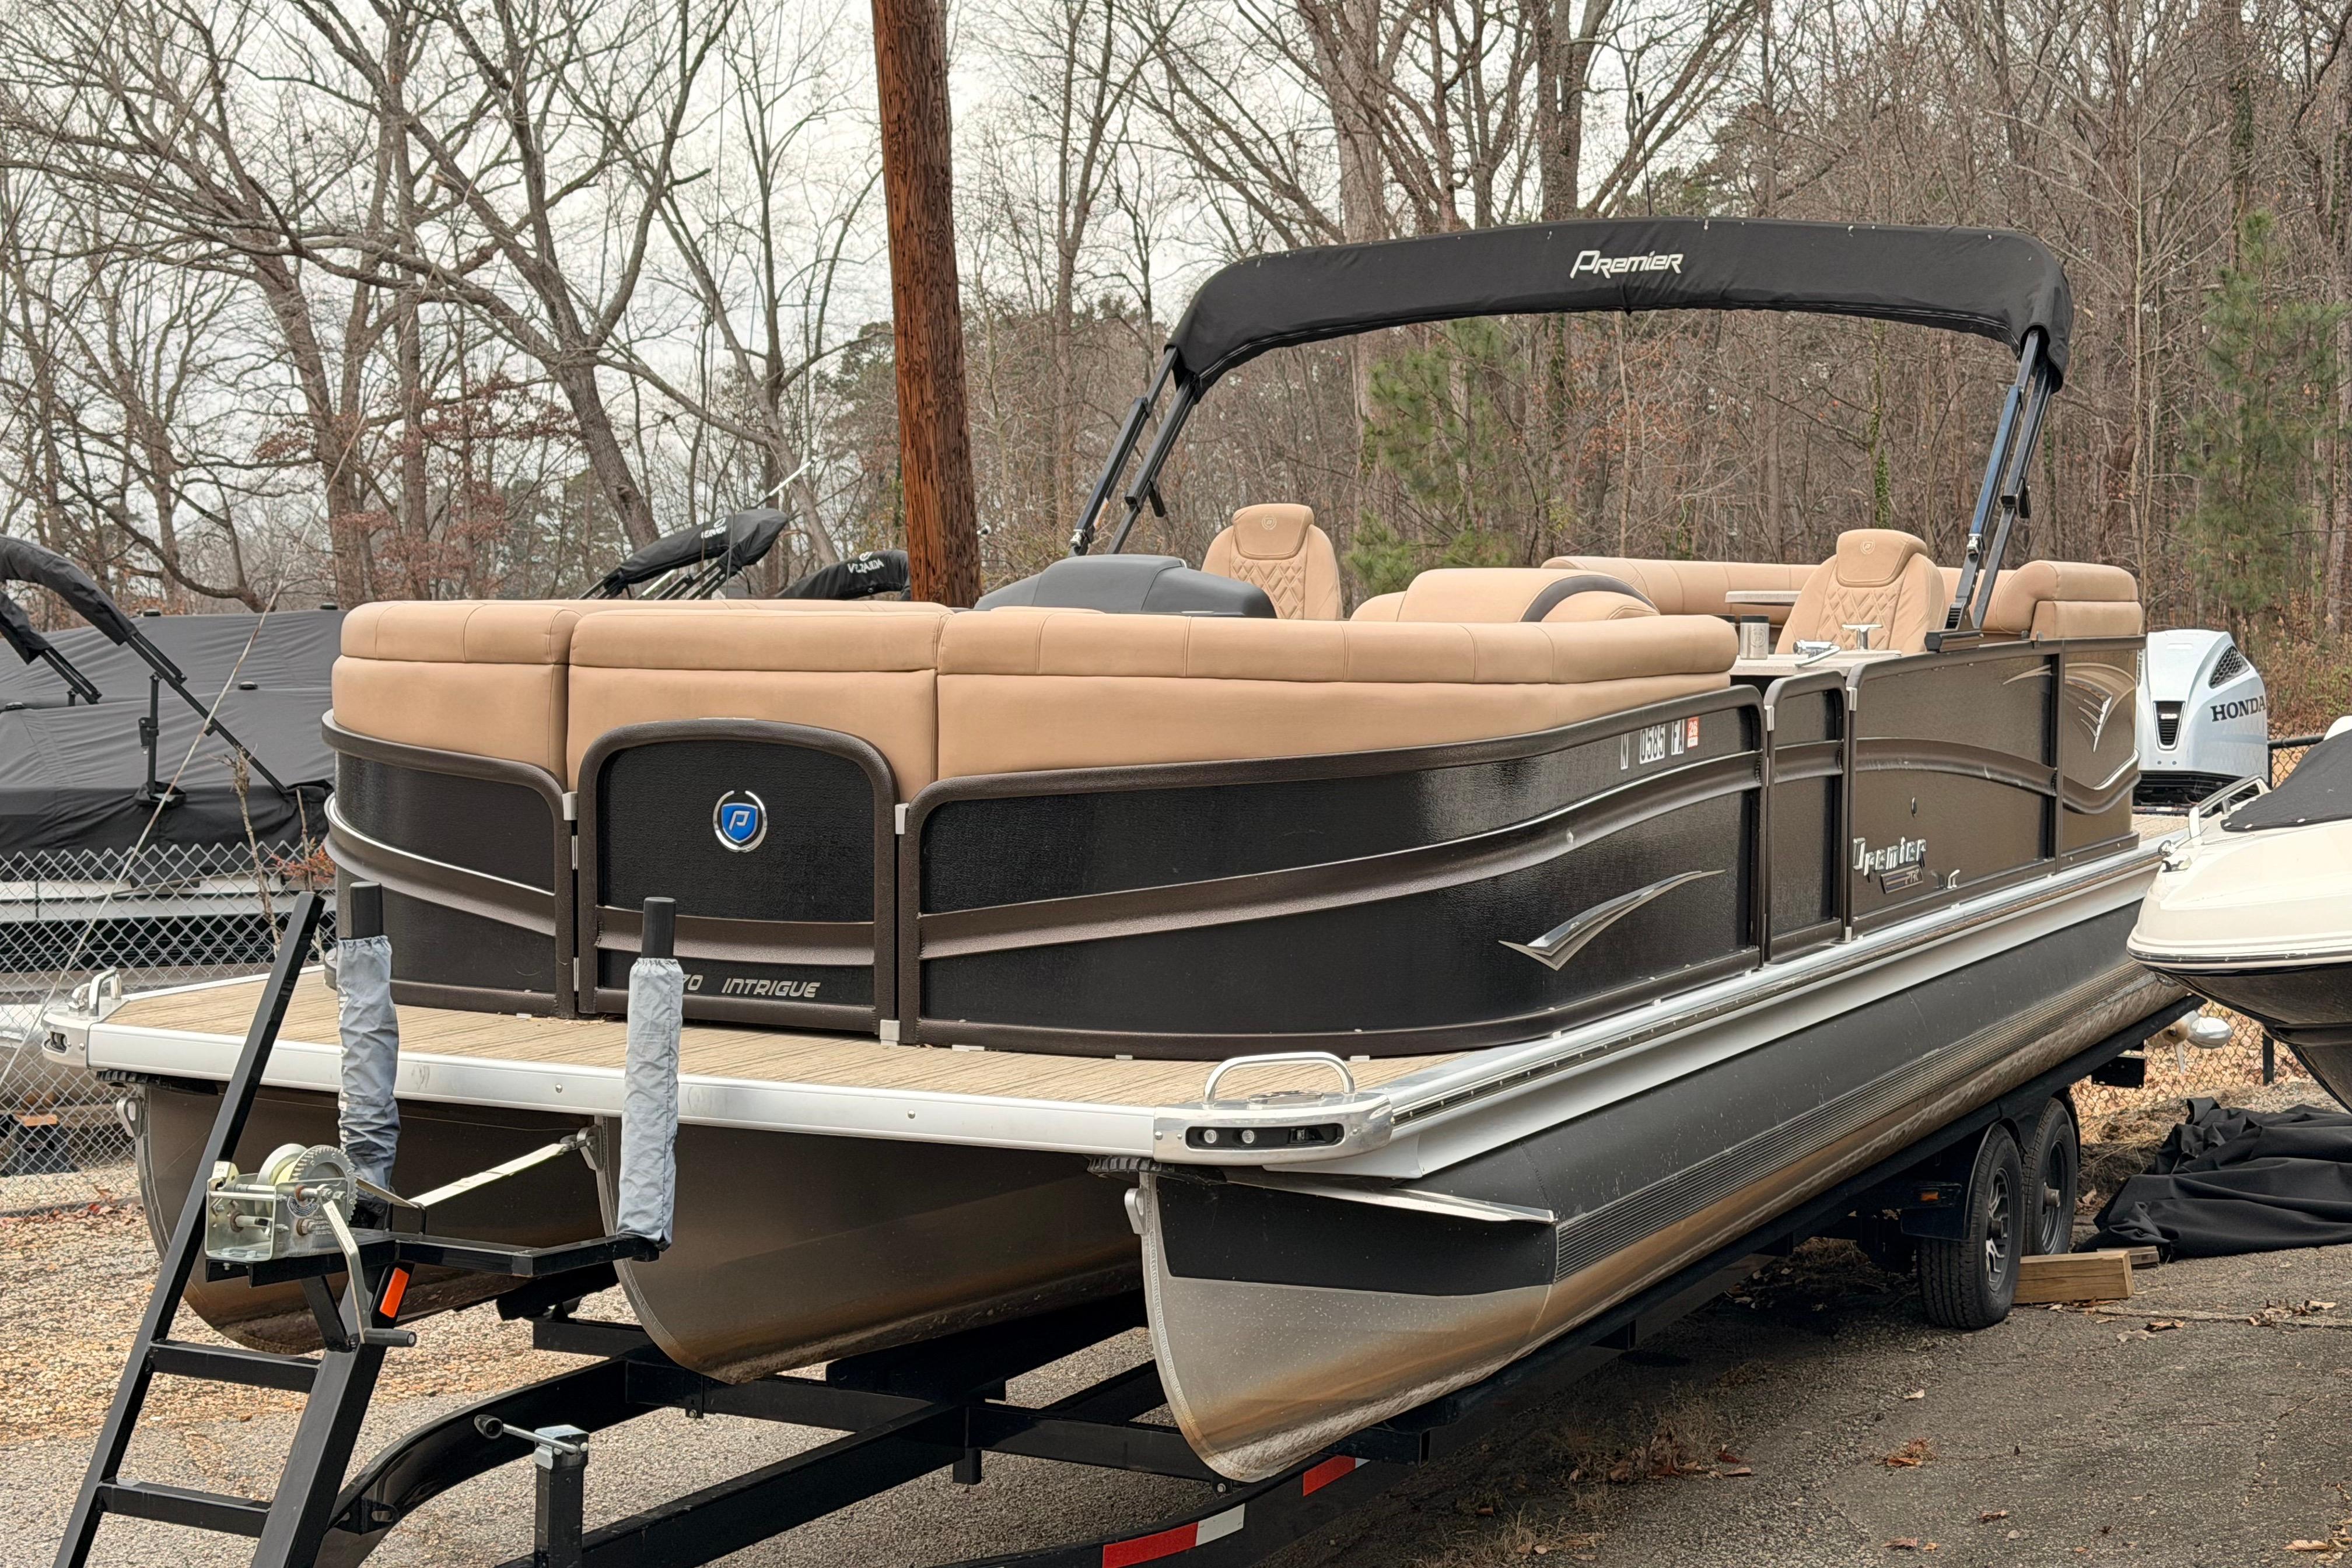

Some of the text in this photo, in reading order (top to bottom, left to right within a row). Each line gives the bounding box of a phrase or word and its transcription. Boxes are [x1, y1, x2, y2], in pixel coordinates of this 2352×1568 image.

[2210, 695, 2267, 722] HONDA
[1640, 724, 1665, 764] 0585
[1671, 719, 1685, 755] FA
[729, 811, 750, 831] P
[722, 978, 821, 998] INTRIGUE
